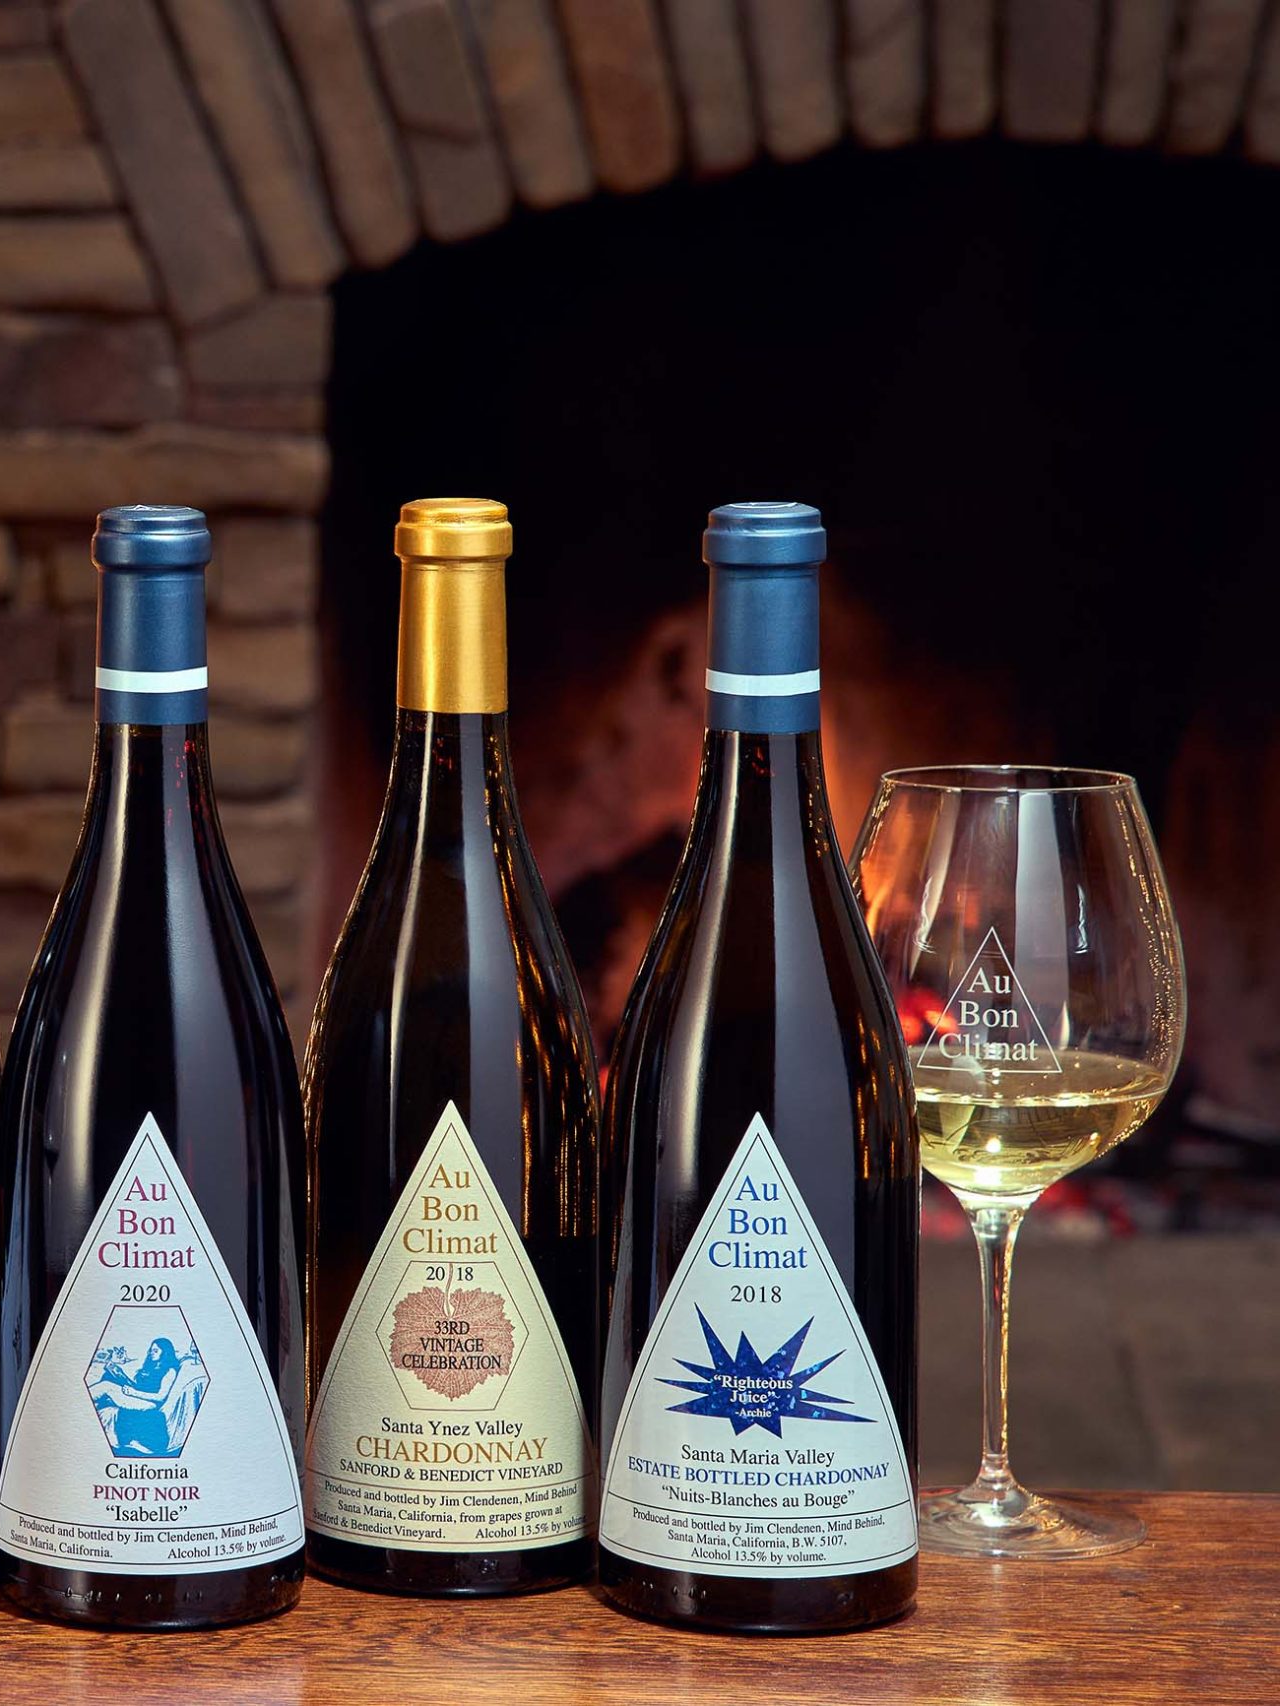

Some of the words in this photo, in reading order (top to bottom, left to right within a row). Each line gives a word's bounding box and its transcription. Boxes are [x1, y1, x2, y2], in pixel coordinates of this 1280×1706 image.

[967, 967, 1011, 994] Au
[958, 1000, 1019, 1028] Bon
[939, 1033, 1039, 1061] Climat
[124, 1175, 167, 1202] Au
[428, 1163, 471, 1189] Au
[735, 1175, 779, 1201] Au
[421, 1195, 480, 1222] Bon
[117, 1209, 176, 1235] Bon
[727, 1208, 788, 1235] Bon
[402, 1228, 498, 1254] Climat
[98, 1242, 196, 1268] Climat
[708, 1241, 808, 1269] Climat
[120, 1285, 170, 1302] 2020
[730, 1285, 782, 1303] 2018
[434, 1320, 470, 1335] 33RD
[420, 1337, 484, 1352] VINTAGE
[401, 1354, 502, 1370] CELEBRATION
[713, 1374, 793, 1391] “Righteous
[730, 1390, 776, 1404] Juice”
[381, 1417, 423, 1435] Santa
[427, 1420, 470, 1436] Ynez
[475, 1420, 523, 1438] Valley
[356, 1435, 548, 1464] CHARDONNAY
[681, 1444, 725, 1463] Santa
[730, 1449, 780, 1465] Maria
[785, 1449, 835, 1467] Valley
[105, 1463, 189, 1479] California
[340, 1458, 400, 1479] SANFORD
[404, 1468, 415, 1480] &
[419, 1468, 494, 1482] BENEDICT
[498, 1462, 563, 1480] VINEYARD
[628, 1456, 681, 1480] ESTATE
[685, 1467, 770, 1486] BOTTLED
[775, 1462, 889, 1486] CHARDONNAY
[92, 1484, 150, 1500] PINOT
[154, 1486, 200, 1501] NOIR
[325, 1480, 361, 1498] Produced
[364, 1490, 380, 1501] and
[384, 1492, 420, 1505] bottled
[423, 1496, 436, 1508] by
[439, 1496, 459, 1507] Jim
[463, 1496, 522, 1507] Clendenen,
[525, 1491, 549, 1503] Mind
[662, 1485, 778, 1507] “Nuits-Blanches
[782, 1497, 799, 1507] au
[804, 1490, 855, 1509] Bouge”
[106, 1505, 187, 1521] “Isabelle”
[338, 1500, 361, 1514] Santa
[363, 1505, 396, 1520] Maria,
[398, 1510, 457, 1523] California,
[460, 1512, 486, 1523] from
[488, 1513, 522, 1525] grapes
[525, 1508, 553, 1522] grown
[554, 1505, 563, 1515] at
[633, 1507, 670, 1525] Produced
[672, 1518, 688, 1528] and
[691, 1518, 726, 1532] bottled
[729, 1522, 741, 1535] by
[745, 1522, 764, 1534] Jim
[766, 1523, 825, 1534] Clendenen,
[827, 1519, 852, 1532] Mind
[854, 1515, 885, 1529] Behind,
[19, 1516, 55, 1534] Produced
[58, 1527, 74, 1537] and
[78, 1528, 113, 1541] bottled
[117, 1531, 130, 1544] by
[134, 1532, 154, 1542] Jim
[157, 1531, 218, 1542] Clendenen,
[221, 1525, 246, 1539] Mind
[248, 1518, 278, 1534] Behind,
[340, 1518, 348, 1528] &
[351, 1519, 392, 1535] Benedict
[394, 1525, 446, 1540] Vineyard.
[475, 1526, 517, 1539] Alcohol
[521, 1521, 549, 1536] 13.5%
[551, 1520, 561, 1533] by
[668, 1529, 694, 1543] Santa
[696, 1534, 730, 1547] Maria,
[732, 1537, 789, 1549] California,
[792, 1537, 817, 1548] B.W.
[820, 1535, 847, 1546] 5107,
[10, 1530, 28, 1545] Santa
[30, 1536, 57, 1553] Maria,
[59, 1542, 113, 1558] California.
[167, 1547, 211, 1559] Alcohol
[214, 1542, 244, 1556] 13.5%
[246, 1540, 257, 1553] by
[691, 1547, 731, 1561] Alcohol
[734, 1550, 767, 1562] 13.5%
[770, 1551, 783, 1564] by
[787, 1551, 826, 1562] volume.
